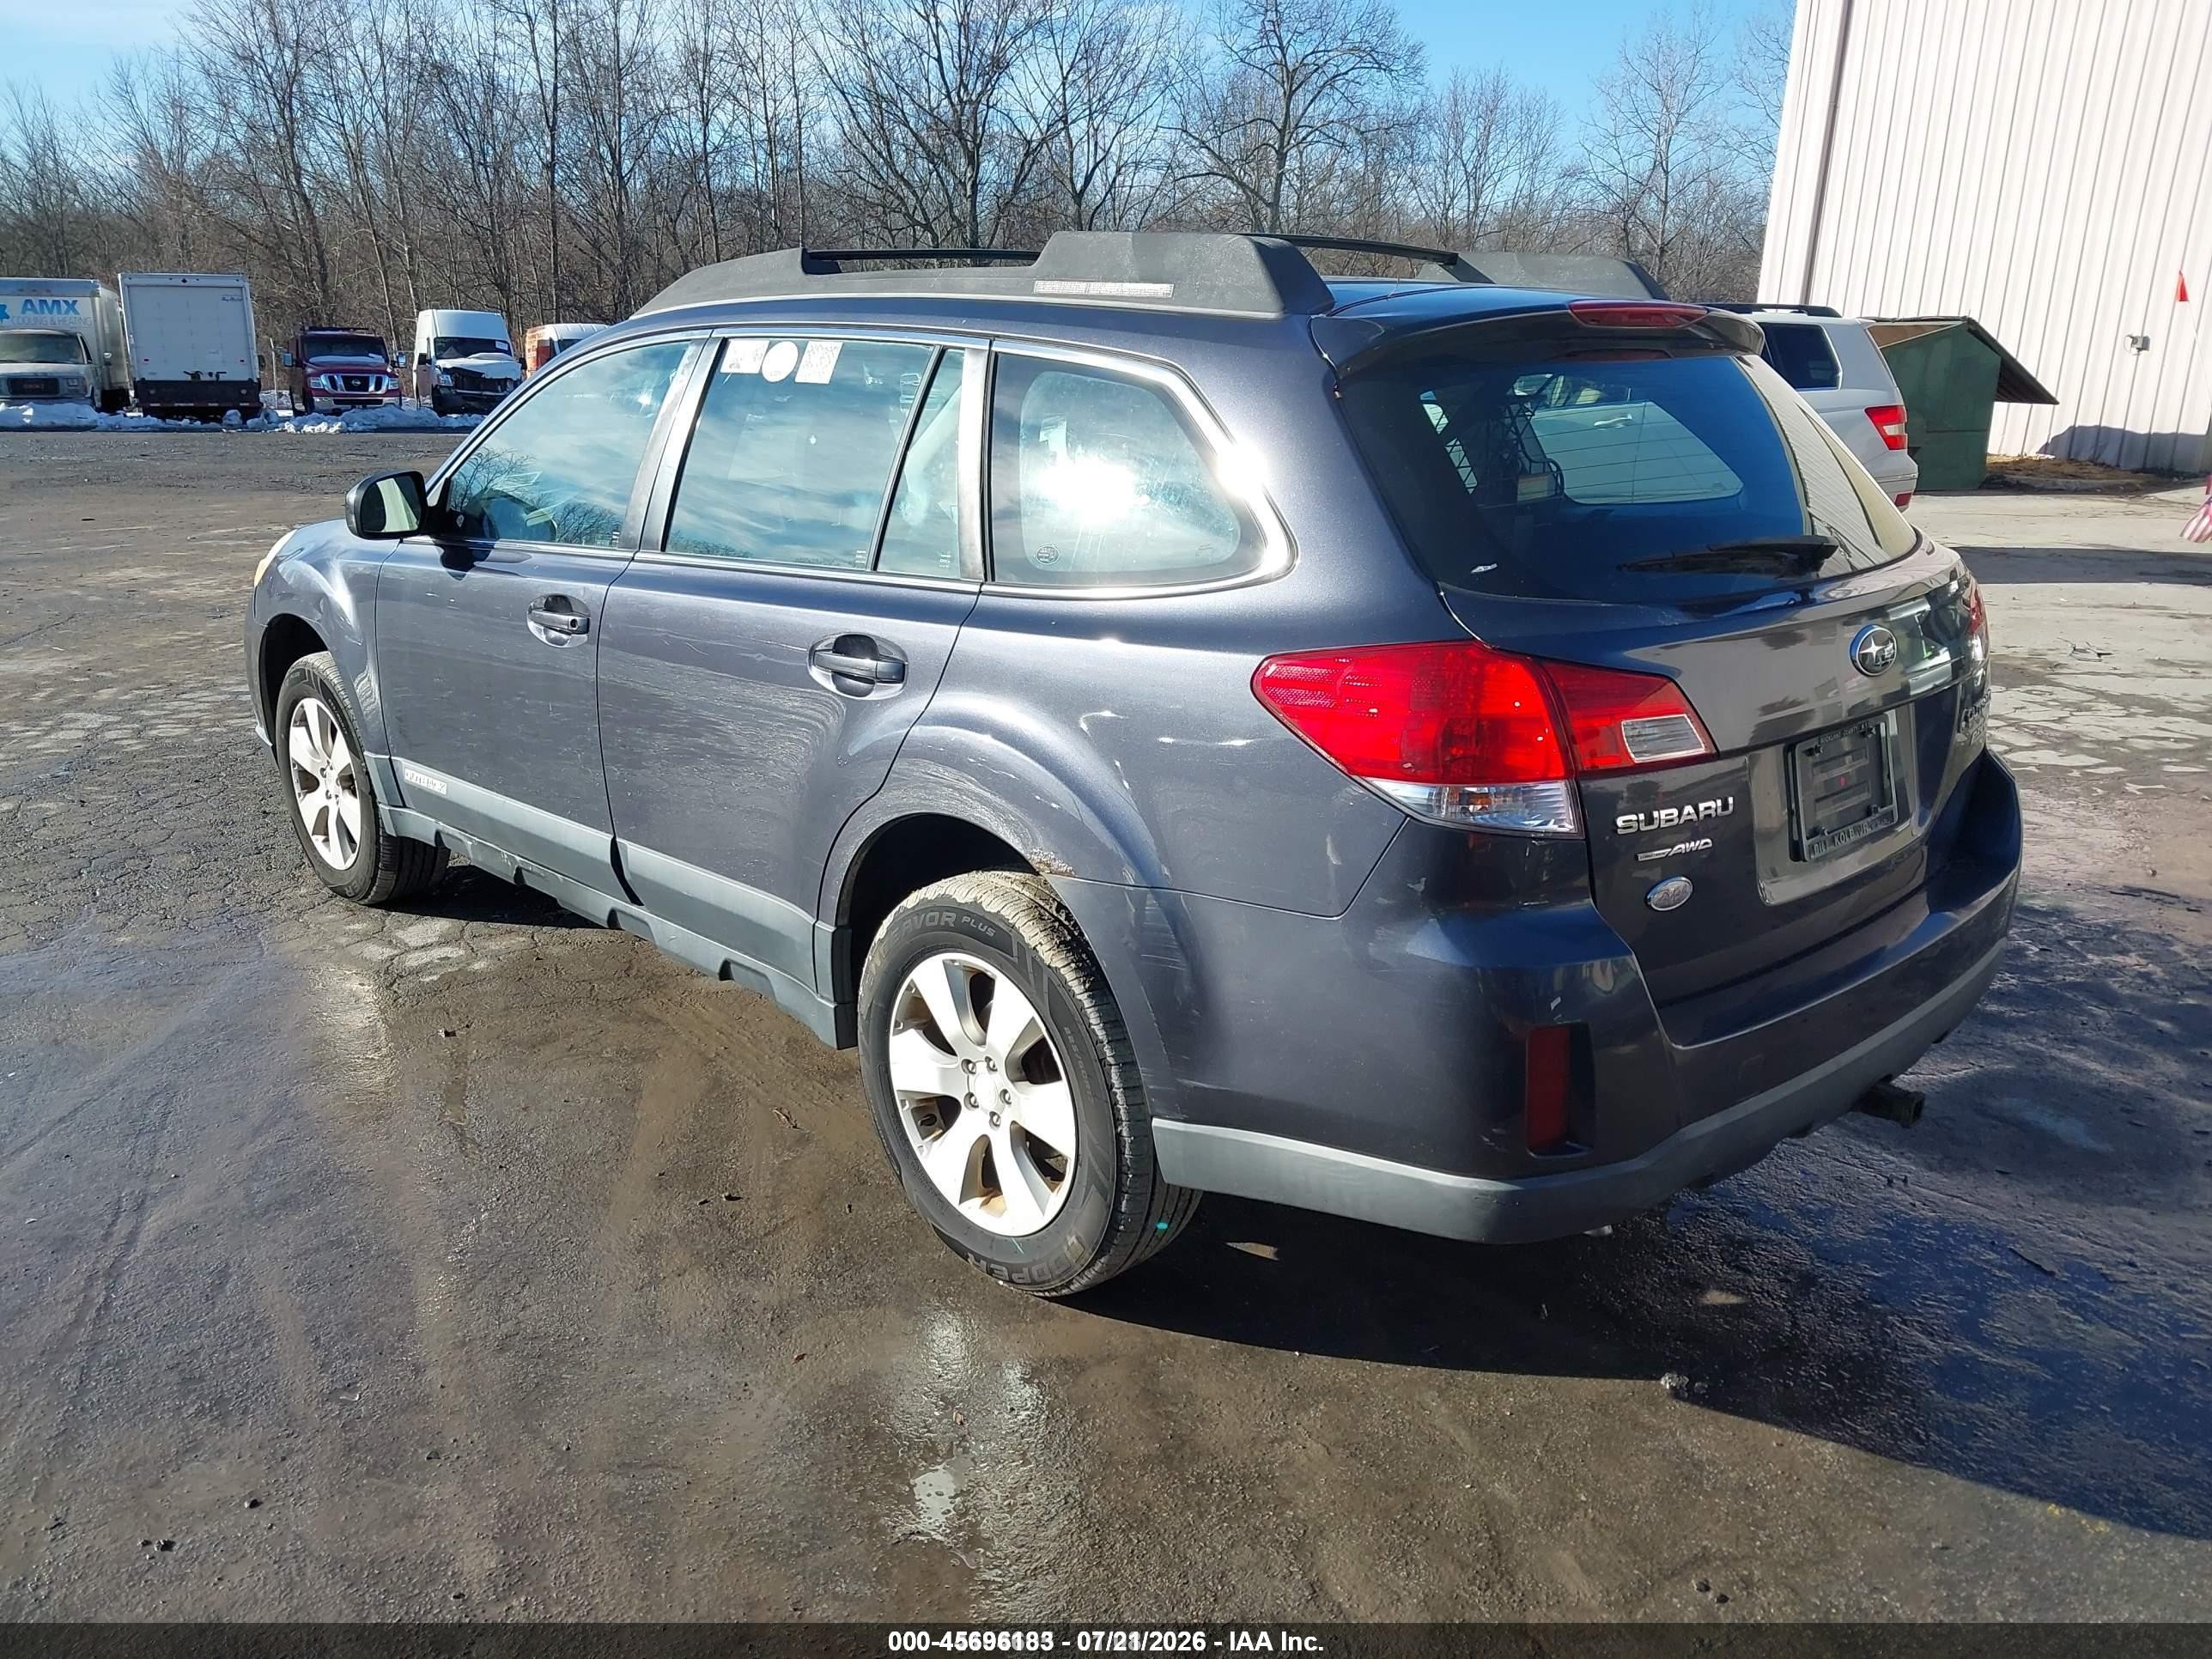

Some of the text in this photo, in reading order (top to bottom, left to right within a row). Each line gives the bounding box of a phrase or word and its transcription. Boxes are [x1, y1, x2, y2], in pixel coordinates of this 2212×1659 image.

[21, 299, 80, 314] AMX
[11, 316, 46, 325] COOLING
[58, 316, 93, 326] HEATING
[1616, 796, 1734, 835] SUBARU
[1668, 838, 1712, 857] AWD
[961, 915, 996, 938] PLUS
[967, 1234, 1085, 1285] COOPER
